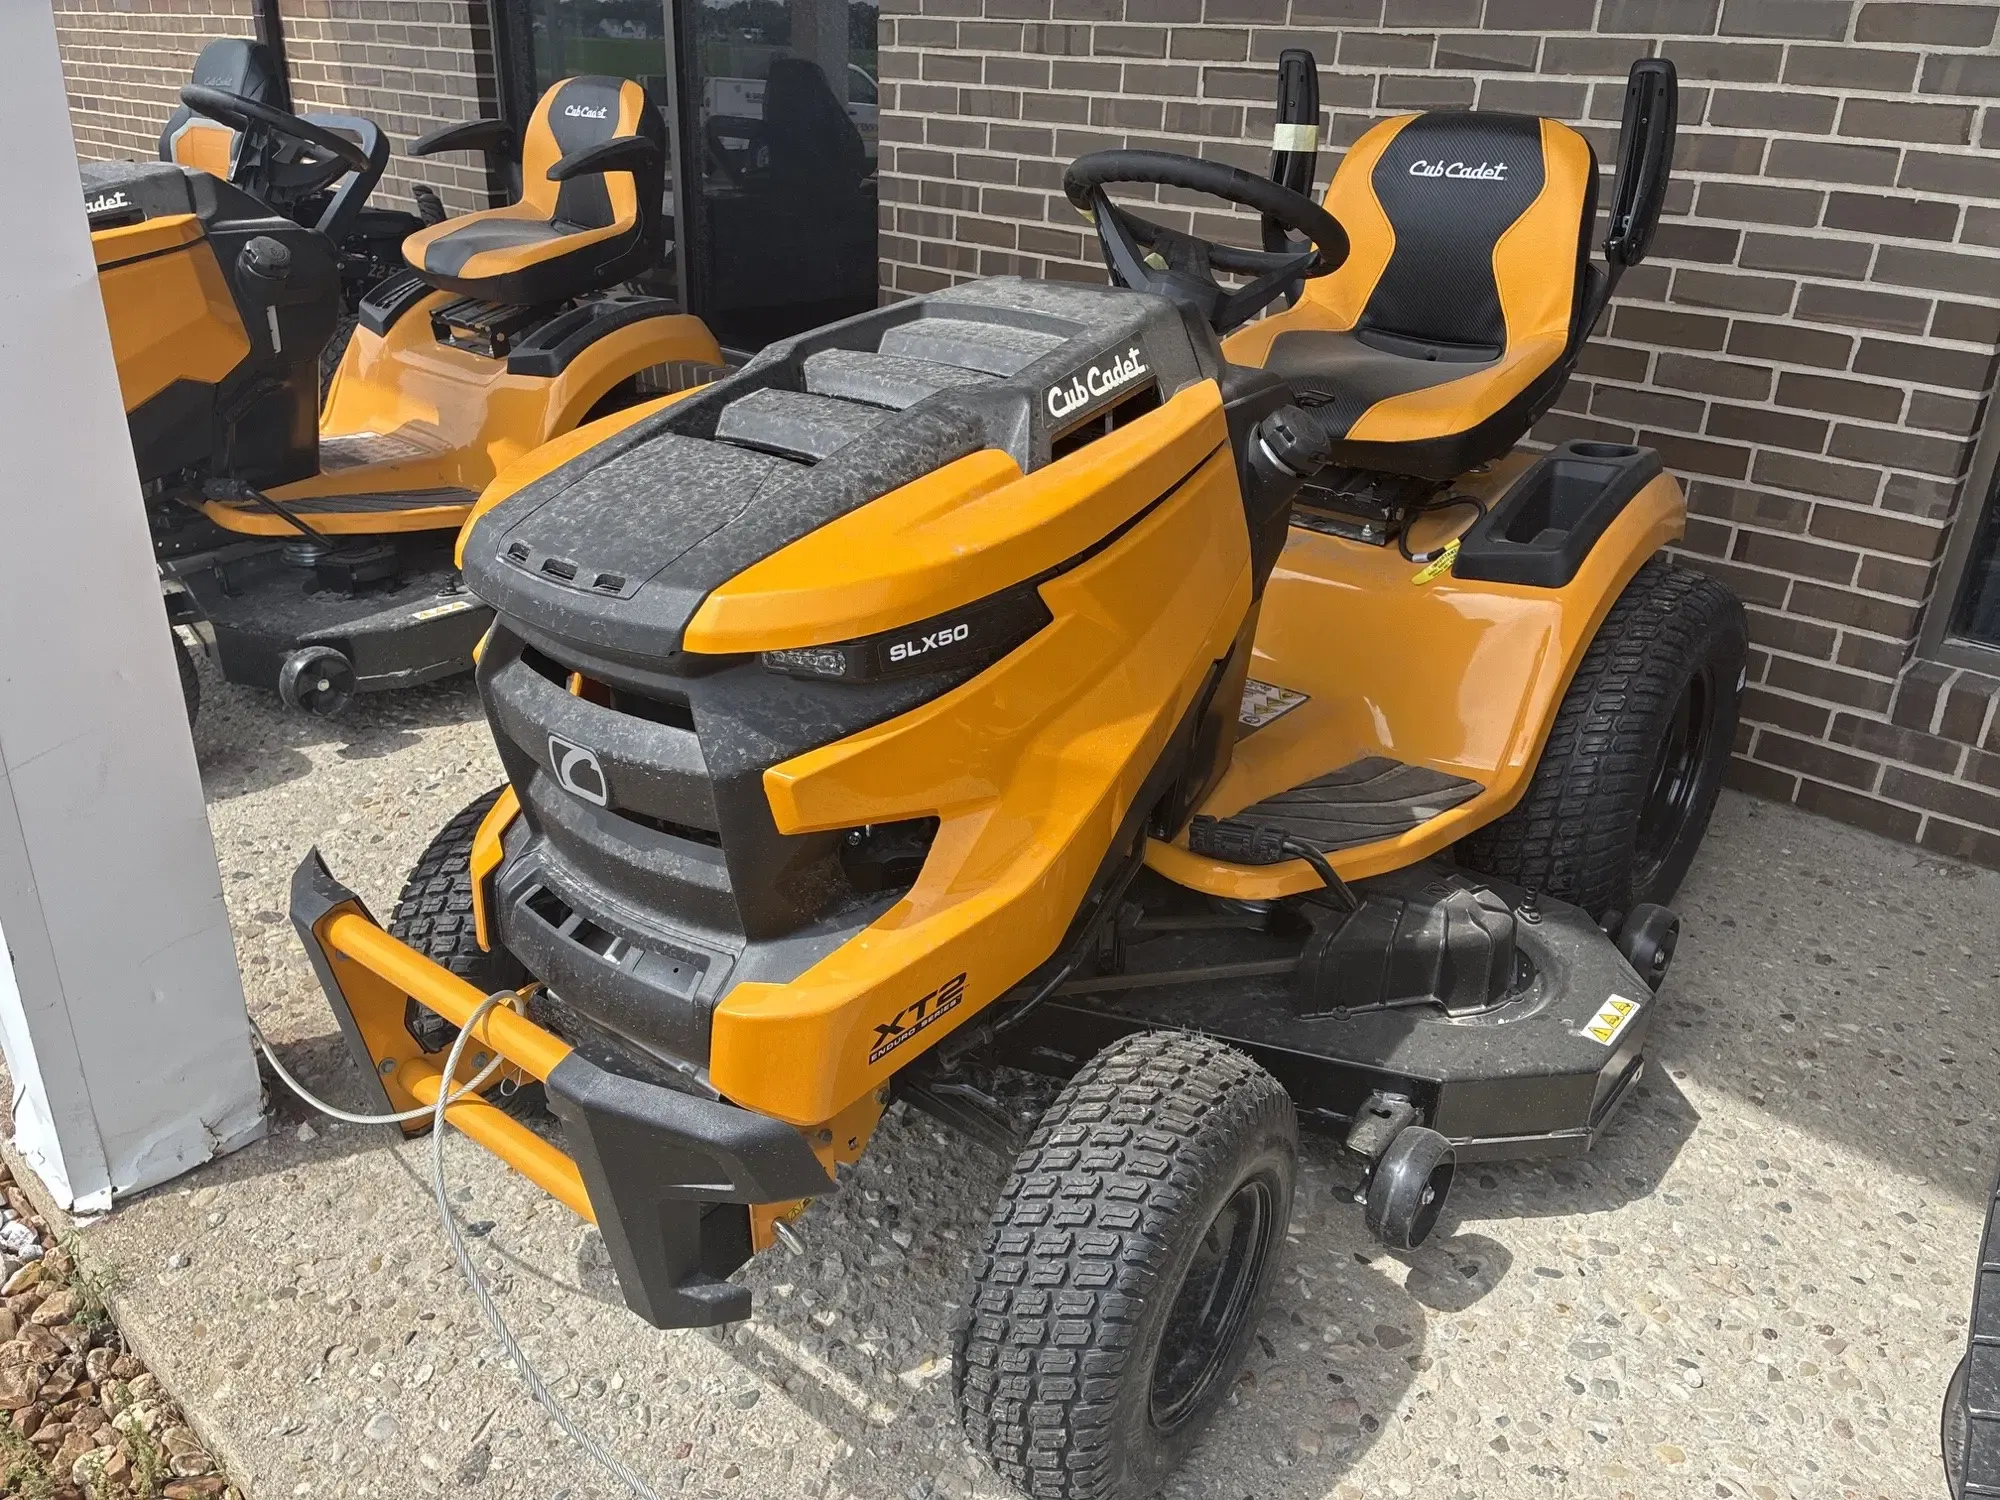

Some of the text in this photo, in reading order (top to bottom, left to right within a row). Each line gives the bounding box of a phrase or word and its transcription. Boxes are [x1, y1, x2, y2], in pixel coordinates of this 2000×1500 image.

[565, 105, 581, 117] Cub
[1409, 160, 1508, 180] Cub Cadet
[85, 191, 128, 213] adet
[1047, 347, 1147, 418] Cub Cadet
[889, 623, 969, 662] SLX50
[870, 971, 967, 1052] XT2
[870, 999, 957, 1062] ENDURO SERIES
